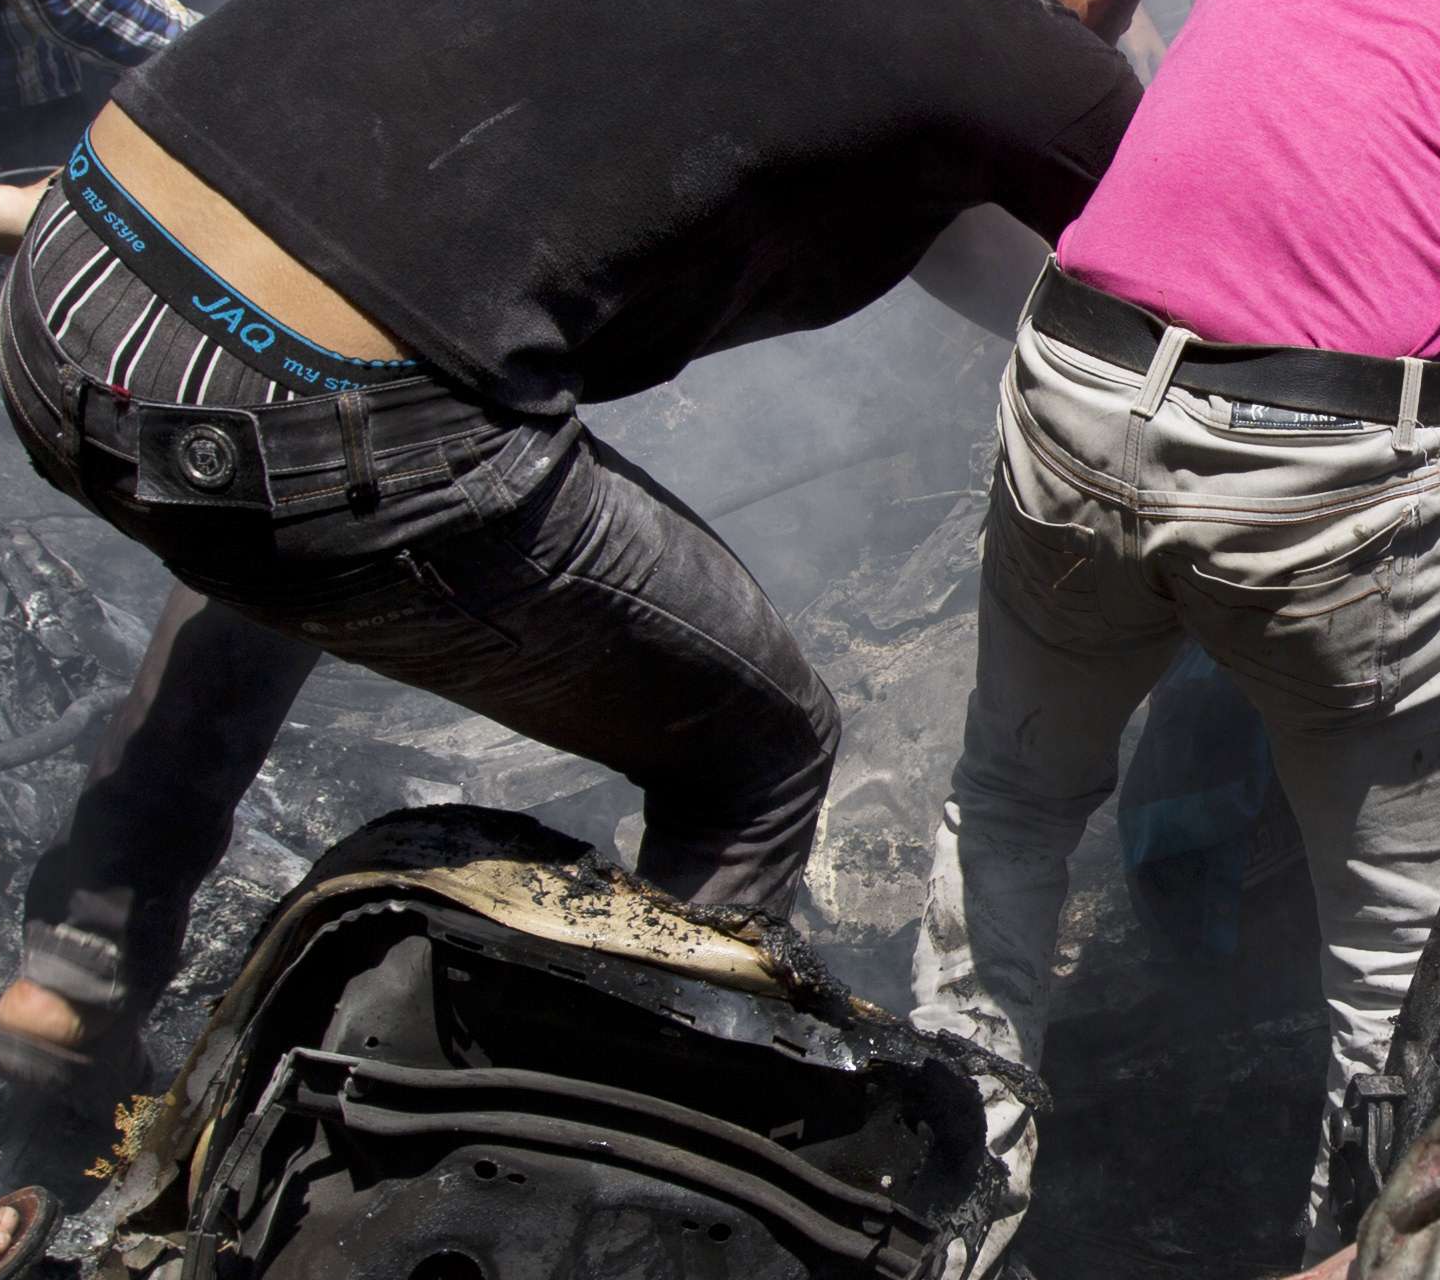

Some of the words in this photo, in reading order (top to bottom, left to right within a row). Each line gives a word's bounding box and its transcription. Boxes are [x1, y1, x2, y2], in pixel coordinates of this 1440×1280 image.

[81, 186, 109, 214] my
[103, 210, 146, 253] style
[192, 292, 277, 354] JAQ
[282, 355, 320, 384] my
[1293, 412, 1337, 423] JEANS
